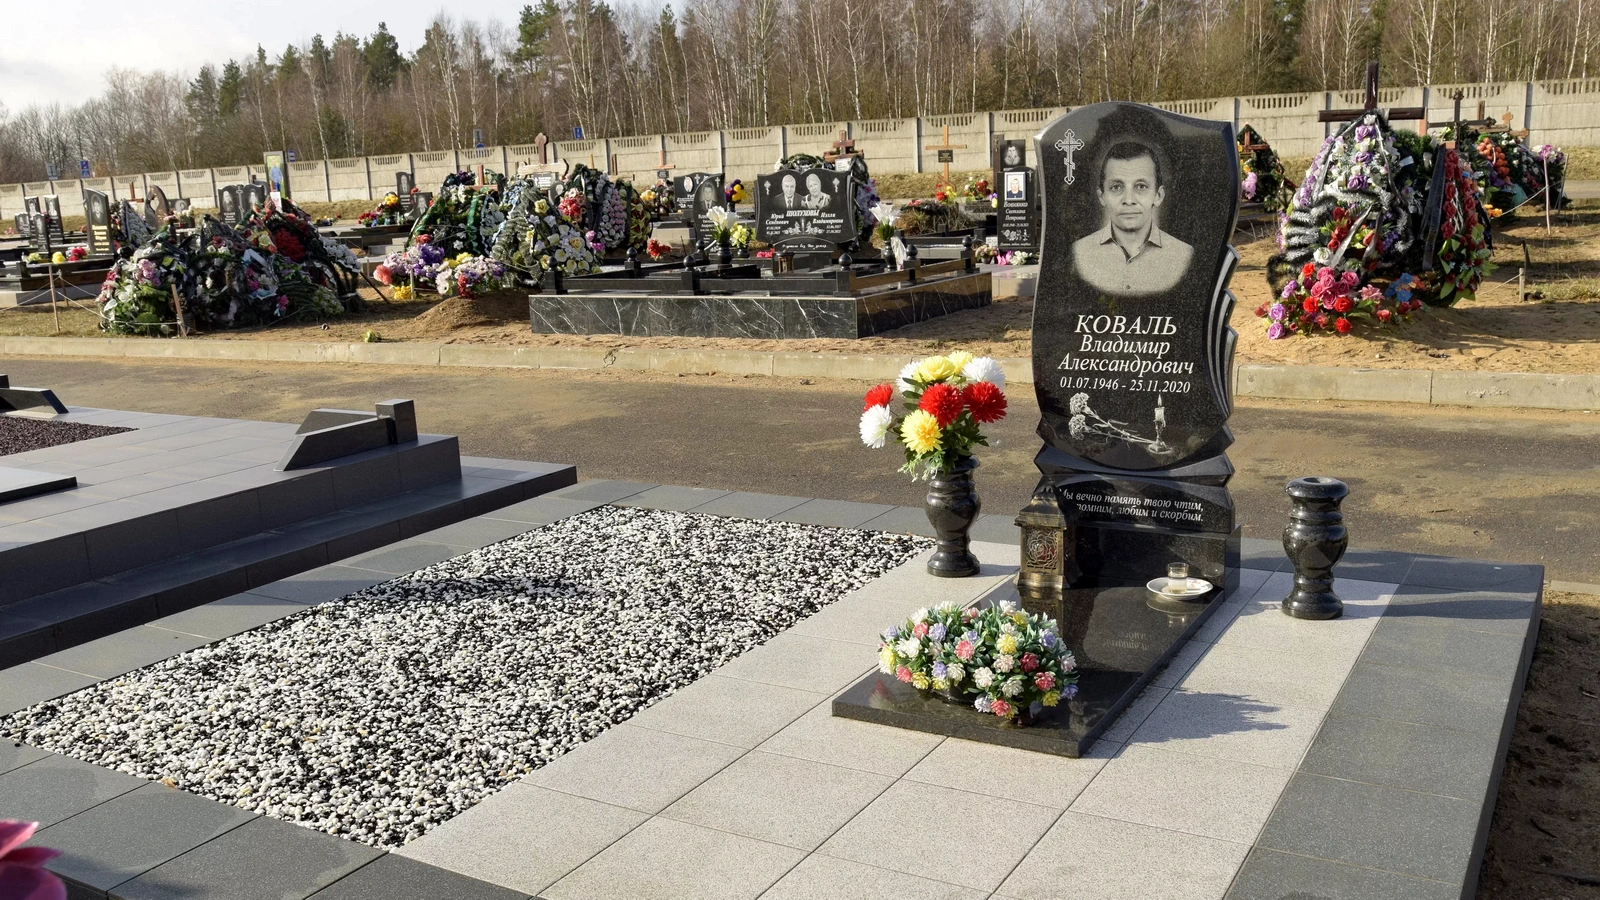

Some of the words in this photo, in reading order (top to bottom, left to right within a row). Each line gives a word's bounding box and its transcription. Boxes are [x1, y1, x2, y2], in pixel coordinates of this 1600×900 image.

[1074, 314, 1178, 335] КОВАЛЬ
[1079, 334, 1171, 360] Владимир
[1057, 352, 1194, 378] Александрович
[1059, 376, 1119, 391] 01.07.1946
[1129, 379, 1191, 394] 25.11.2020
[1075, 492, 1103, 503] вечно
[1104, 495, 1142, 506] память
[1143, 498, 1172, 508] твою
[1174, 500, 1204, 512] чтим,
[1116, 504, 1149, 517] любим
[1151, 509, 1157, 518] и
[1159, 509, 1204, 522] скорбим.
